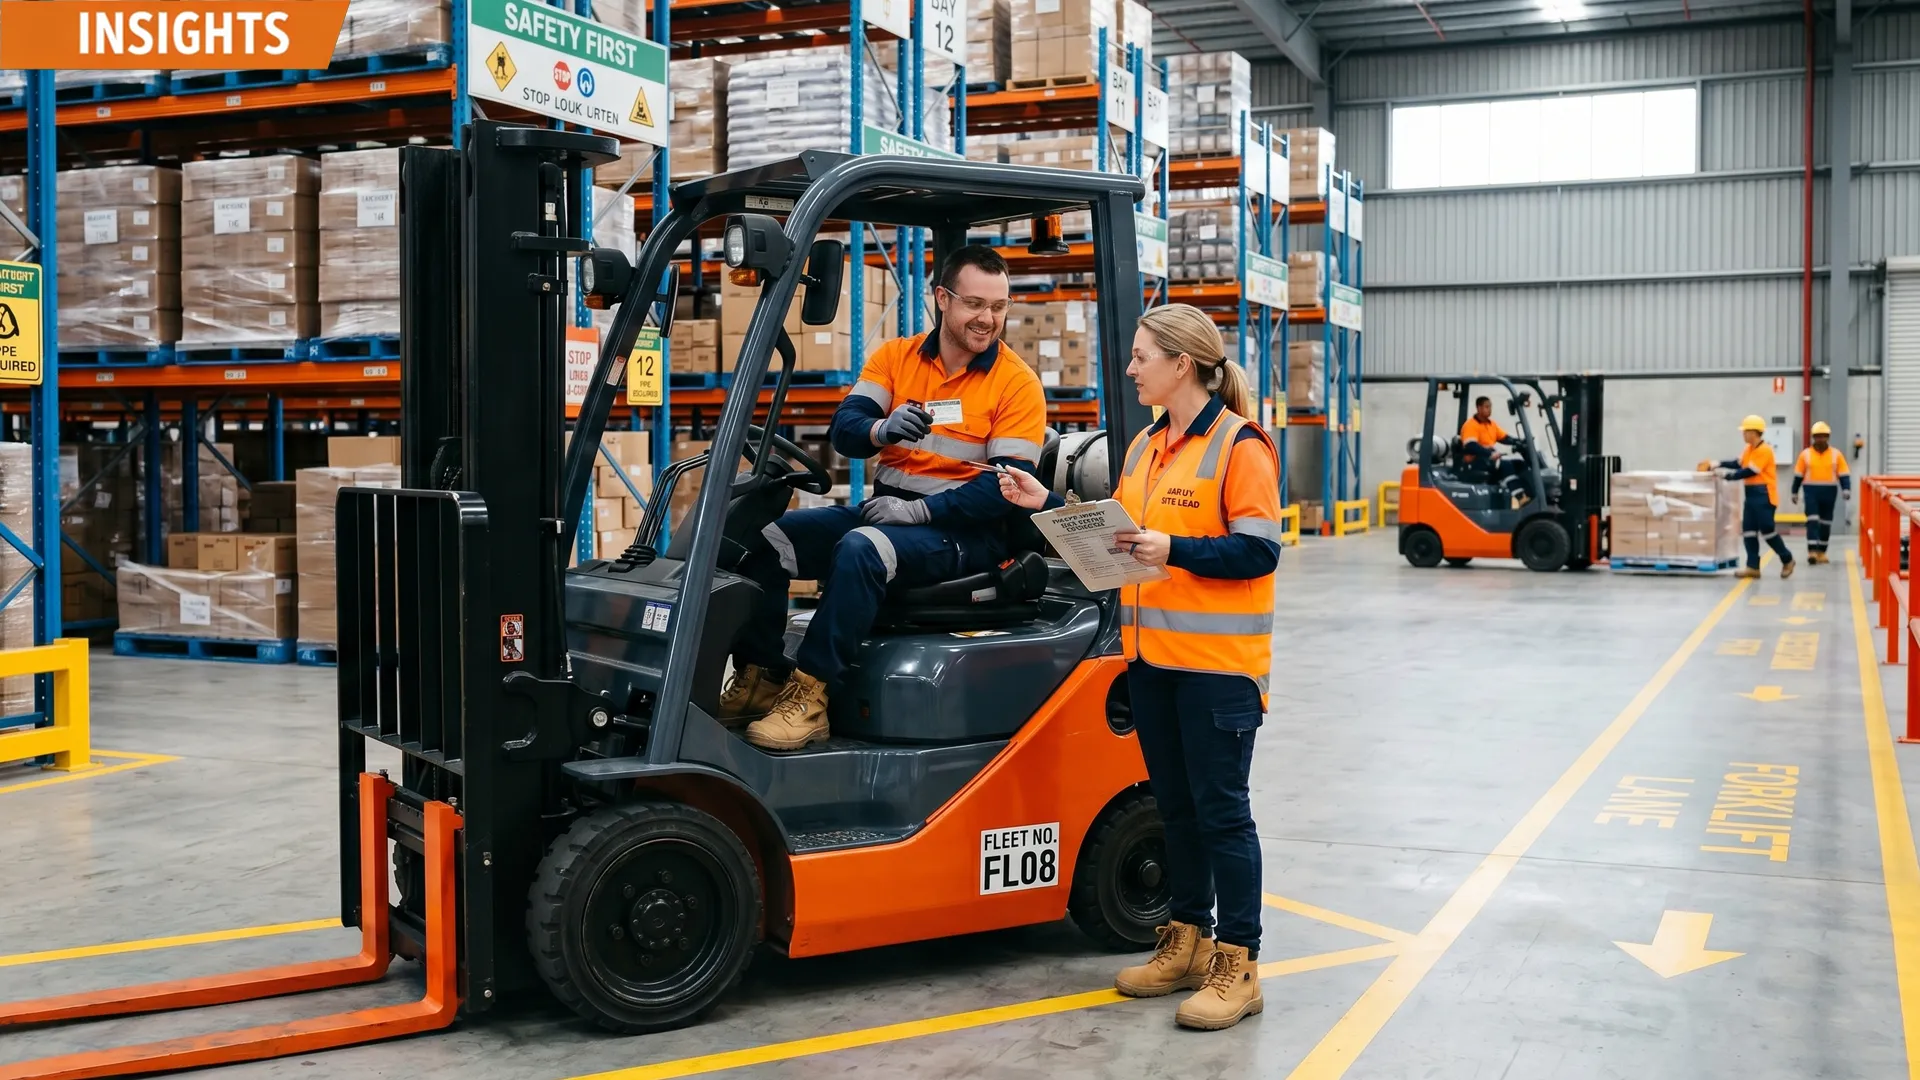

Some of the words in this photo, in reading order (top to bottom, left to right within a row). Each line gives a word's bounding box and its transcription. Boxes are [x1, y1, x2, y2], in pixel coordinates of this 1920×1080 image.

[504, 2, 581, 50] SAFETY
[585, 29, 637, 68] FIRST
[935, 21, 954, 53] 12
[1113, 71, 1128, 93] BAY
[523, 87, 550, 106] STOP
[0, 282, 24, 295] IRST
[0, 345, 17, 357] PE
[568, 350, 592, 365] STOP
[636, 355, 654, 376] 12
[1161, 497, 1177, 505] SITE
[1178, 498, 1200, 508] LEAD
[1593, 775, 1695, 829] LANE
[1700, 762, 1799, 862] FORKLIFT
[984, 829, 1029, 851] FLEET
[1033, 827, 1057, 846] NO.
[984, 849, 1056, 891] FL08
